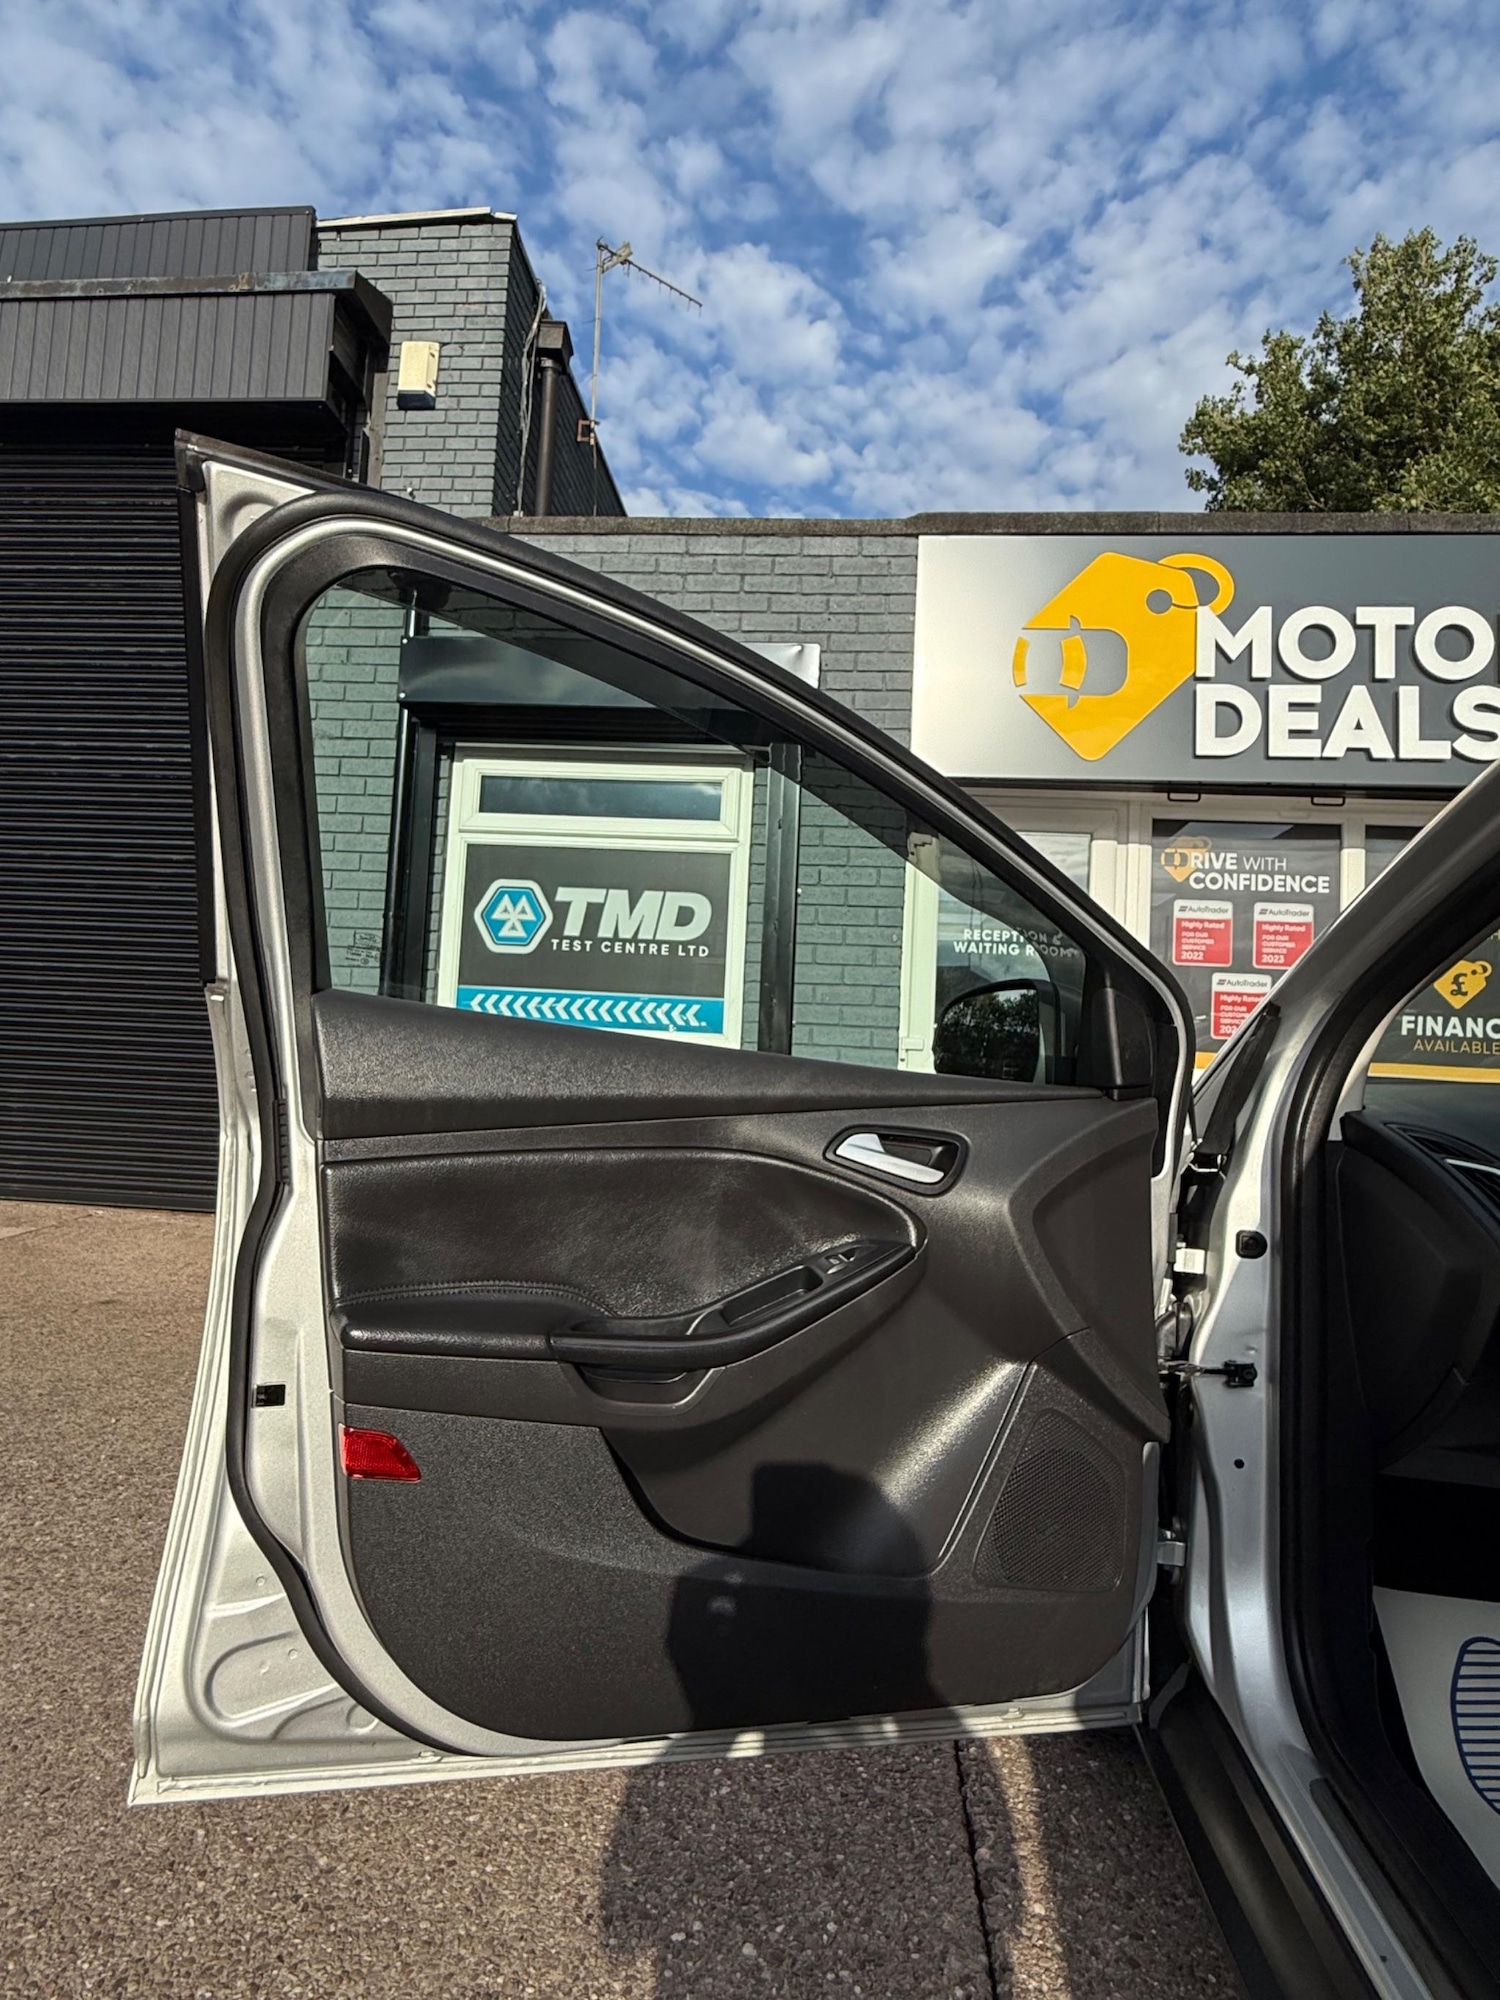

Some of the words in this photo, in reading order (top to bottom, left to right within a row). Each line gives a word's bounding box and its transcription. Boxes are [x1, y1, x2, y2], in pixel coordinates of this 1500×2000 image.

[1195, 684, 1500, 761] DEALS
[1243, 856, 1287, 872] WITH
[1189, 872, 1330, 894] CONFIDENCE
[555, 886, 712, 941] TMD
[551, 938, 593, 952] TEST
[601, 941, 669, 955] CENTRE
[678, 944, 709, 957] LTD
[953, 941, 1020, 956] WAITING
[1181, 951, 1204, 960] 2022
[1262, 954, 1284, 963] 2023
[1219, 1025, 1239, 1034] 202
[1413, 1038, 1500, 1055] AVAILABLE
